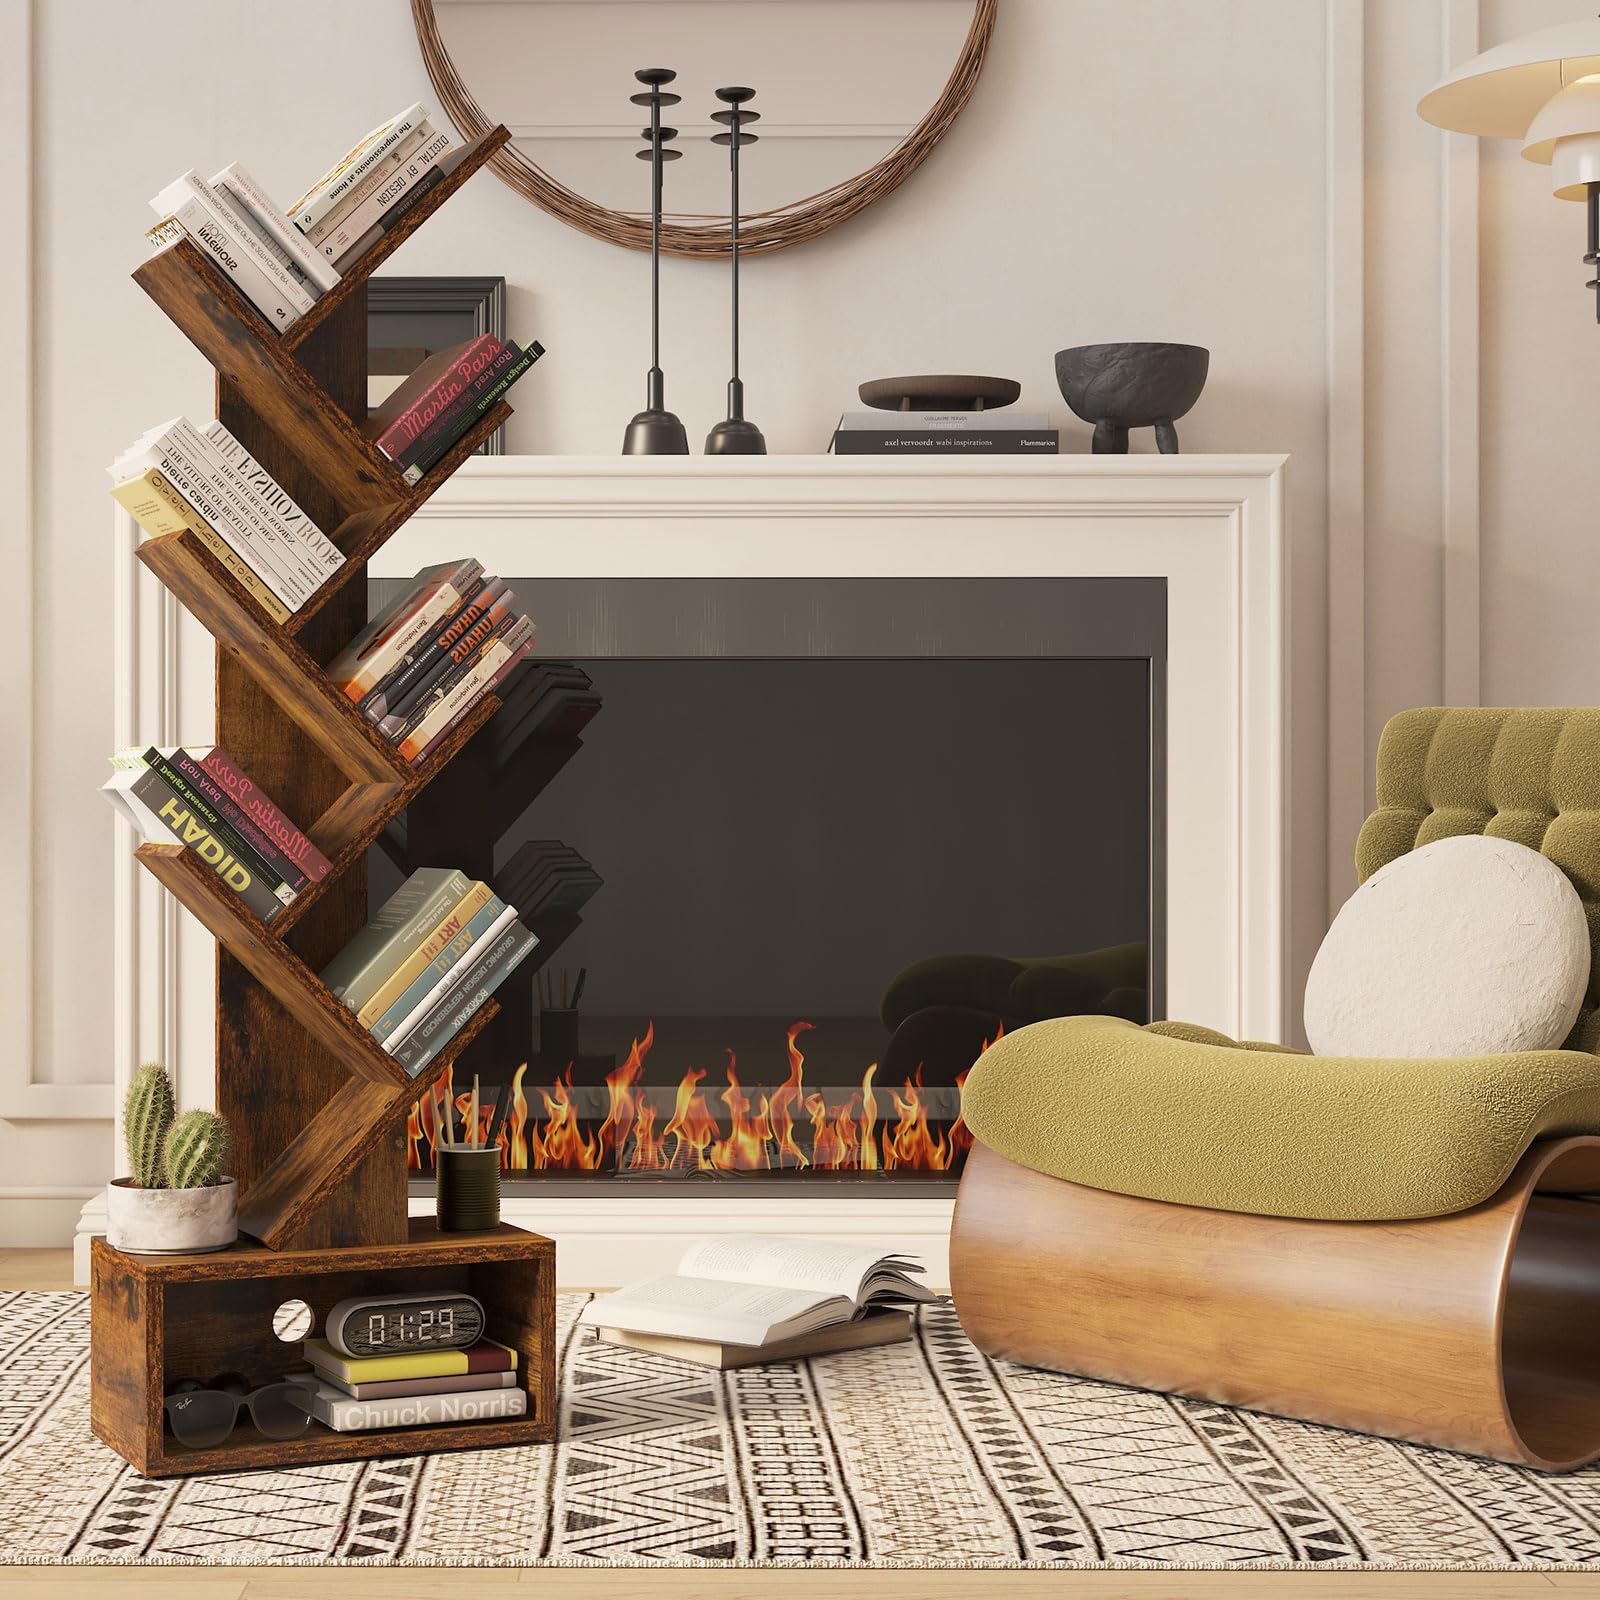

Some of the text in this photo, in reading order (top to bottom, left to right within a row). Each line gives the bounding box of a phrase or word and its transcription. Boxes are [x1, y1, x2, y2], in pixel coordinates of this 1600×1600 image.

[397, 121, 412, 135] The
[353, 131, 400, 176] Impressionists
[416, 134, 449, 166] DIGITAL
[346, 173, 356, 183] at
[404, 164, 419, 178] BY
[328, 180, 349, 201] Home
[375, 175, 406, 207] DESIGN
[492, 349, 513, 369] Ron
[401, 375, 463, 438] Martin
[455, 336, 503, 382] Parr
[473, 366, 496, 389] Arad
[476, 356, 531, 410] Design Research
[954, 439, 992, 447] inspirations
[394, 619, 427, 652] Ben Nicholson
[436, 589, 496, 650] BAUHAUS
[449, 675, 498, 727] FRANK LLOYD WRIGHT
[435, 915, 463, 945] ART
[447, 928, 476, 958] ART
[484, 934, 516, 968] GRAPHIC
[461, 964, 488, 993] DESIGN
[420, 990, 465, 1038] REFERENCED
[450, 987, 488, 1028] BORDEAUX
[369, 1309, 453, 1344] 01:29
[345, 1393, 522, 1429] Chuck Norris
